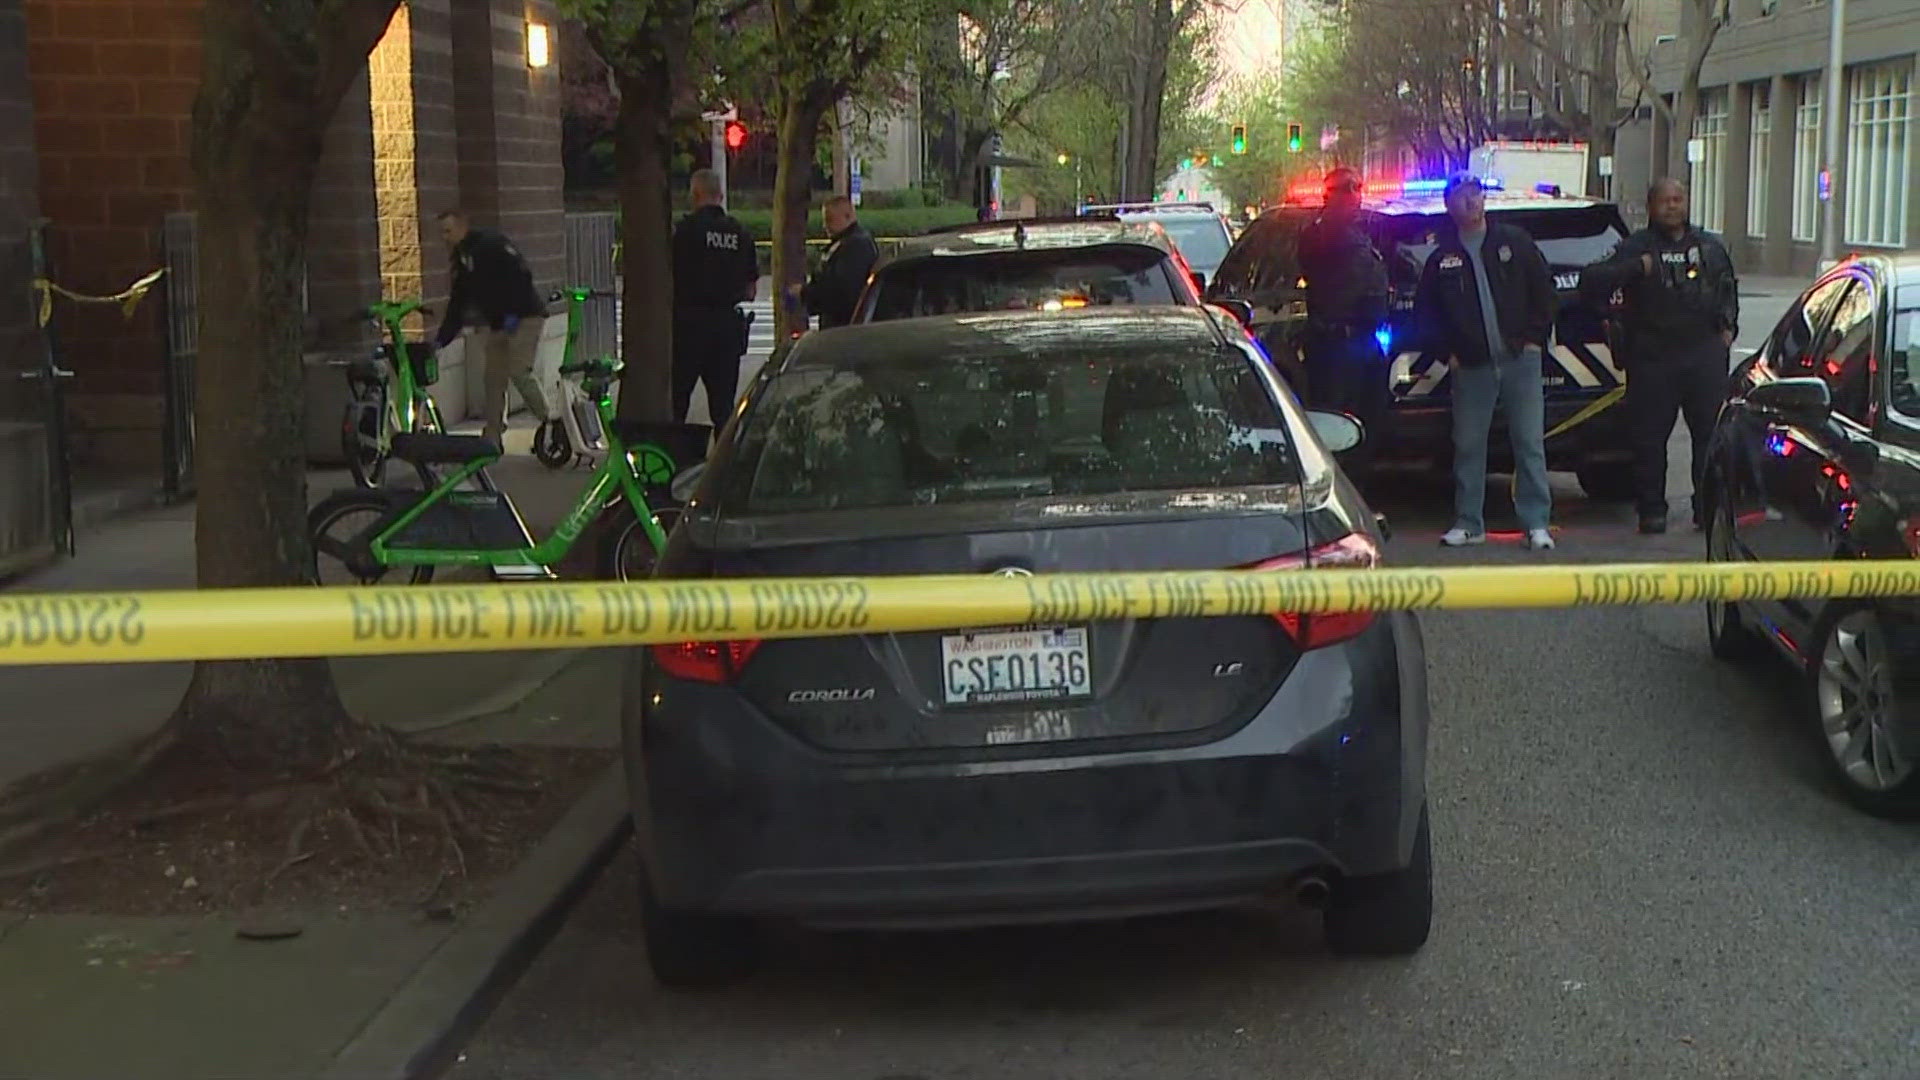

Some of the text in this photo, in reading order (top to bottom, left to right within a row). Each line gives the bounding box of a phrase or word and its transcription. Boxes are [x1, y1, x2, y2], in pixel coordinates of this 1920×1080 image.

[706, 231, 738, 250] POLICE
[1214, 662, 1243, 678] LE
[787, 687, 876, 702] COROLLA
